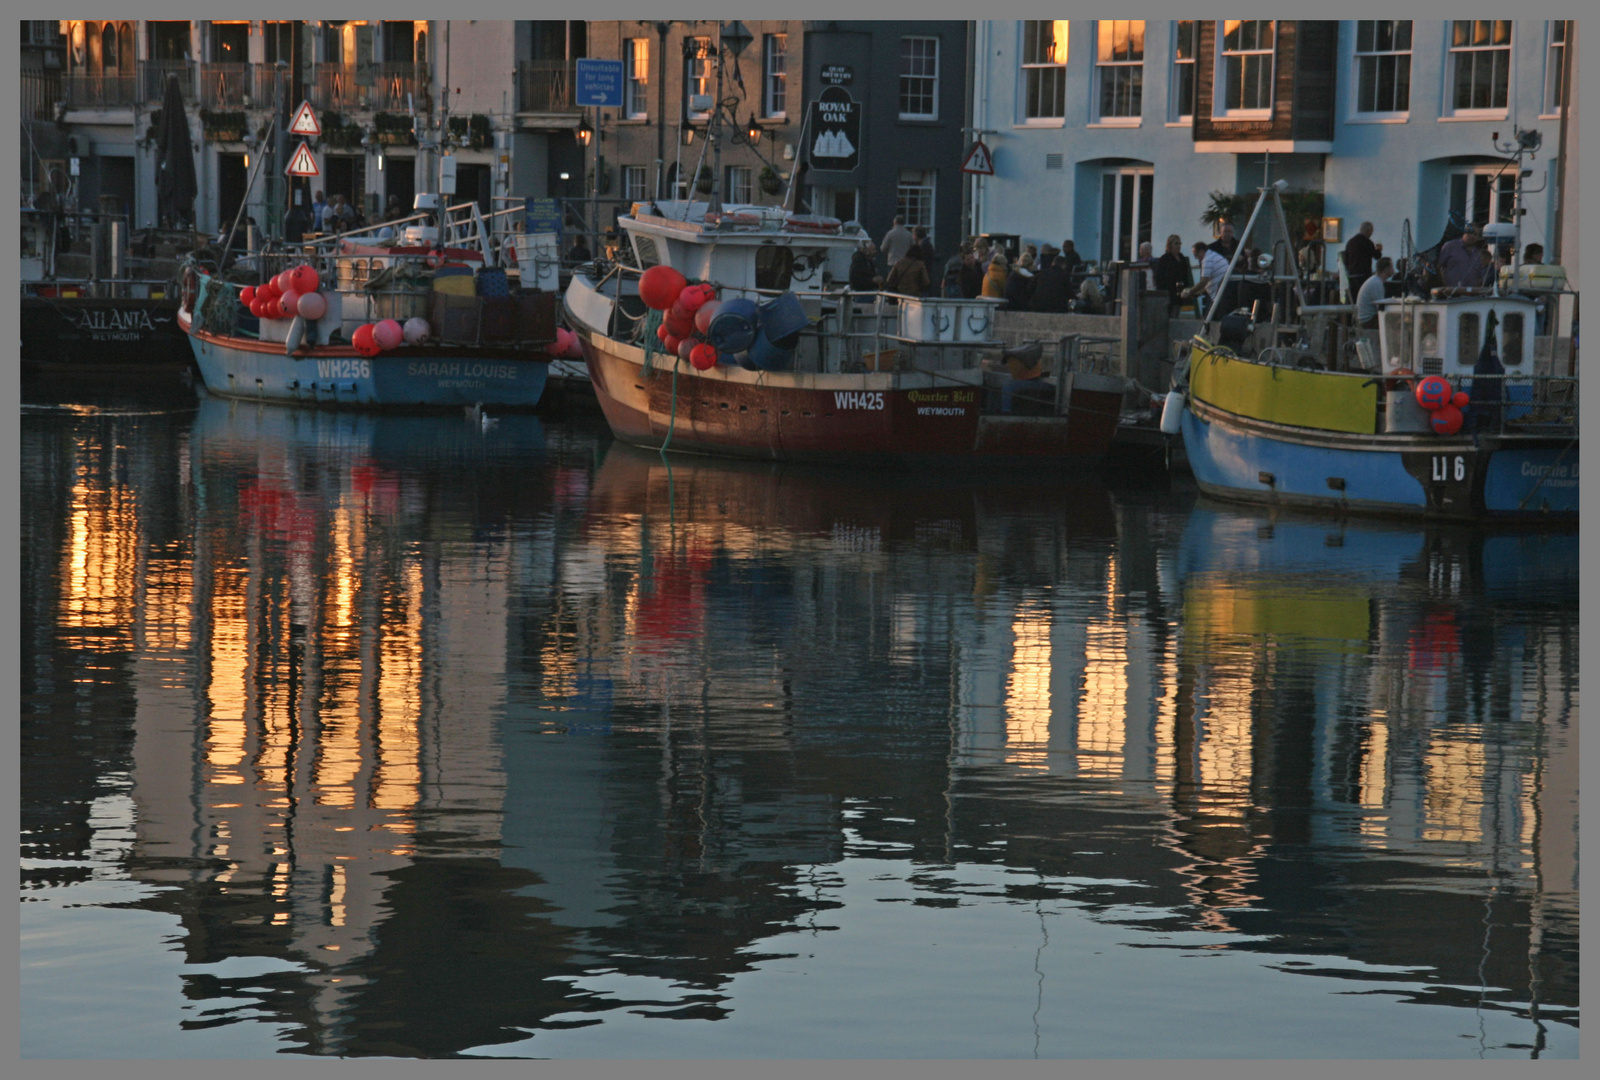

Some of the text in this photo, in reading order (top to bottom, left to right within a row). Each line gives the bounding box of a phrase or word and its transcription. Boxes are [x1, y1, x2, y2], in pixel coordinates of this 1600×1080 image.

[580, 63, 620, 73] Unsuitable
[585, 73, 614, 83] for long
[822, 71, 852, 79] BREWERY
[585, 83, 614, 91] vehicles
[819, 102, 853, 112] ROYAL
[823, 113, 847, 122] OAK
[80, 308, 157, 330] ATLANTA
[92, 332, 140, 341] WEYMOUTH
[317, 360, 370, 378] WH256
[407, 362, 517, 379] SARAH LOUISE
[438, 379, 486, 389] WEYMOUTH
[834, 391, 884, 410] WH425
[908, 390, 974, 403] Quarter Bell
[917, 407, 965, 416] WEYMOUTH
[1454, 456, 1465, 481] 6
